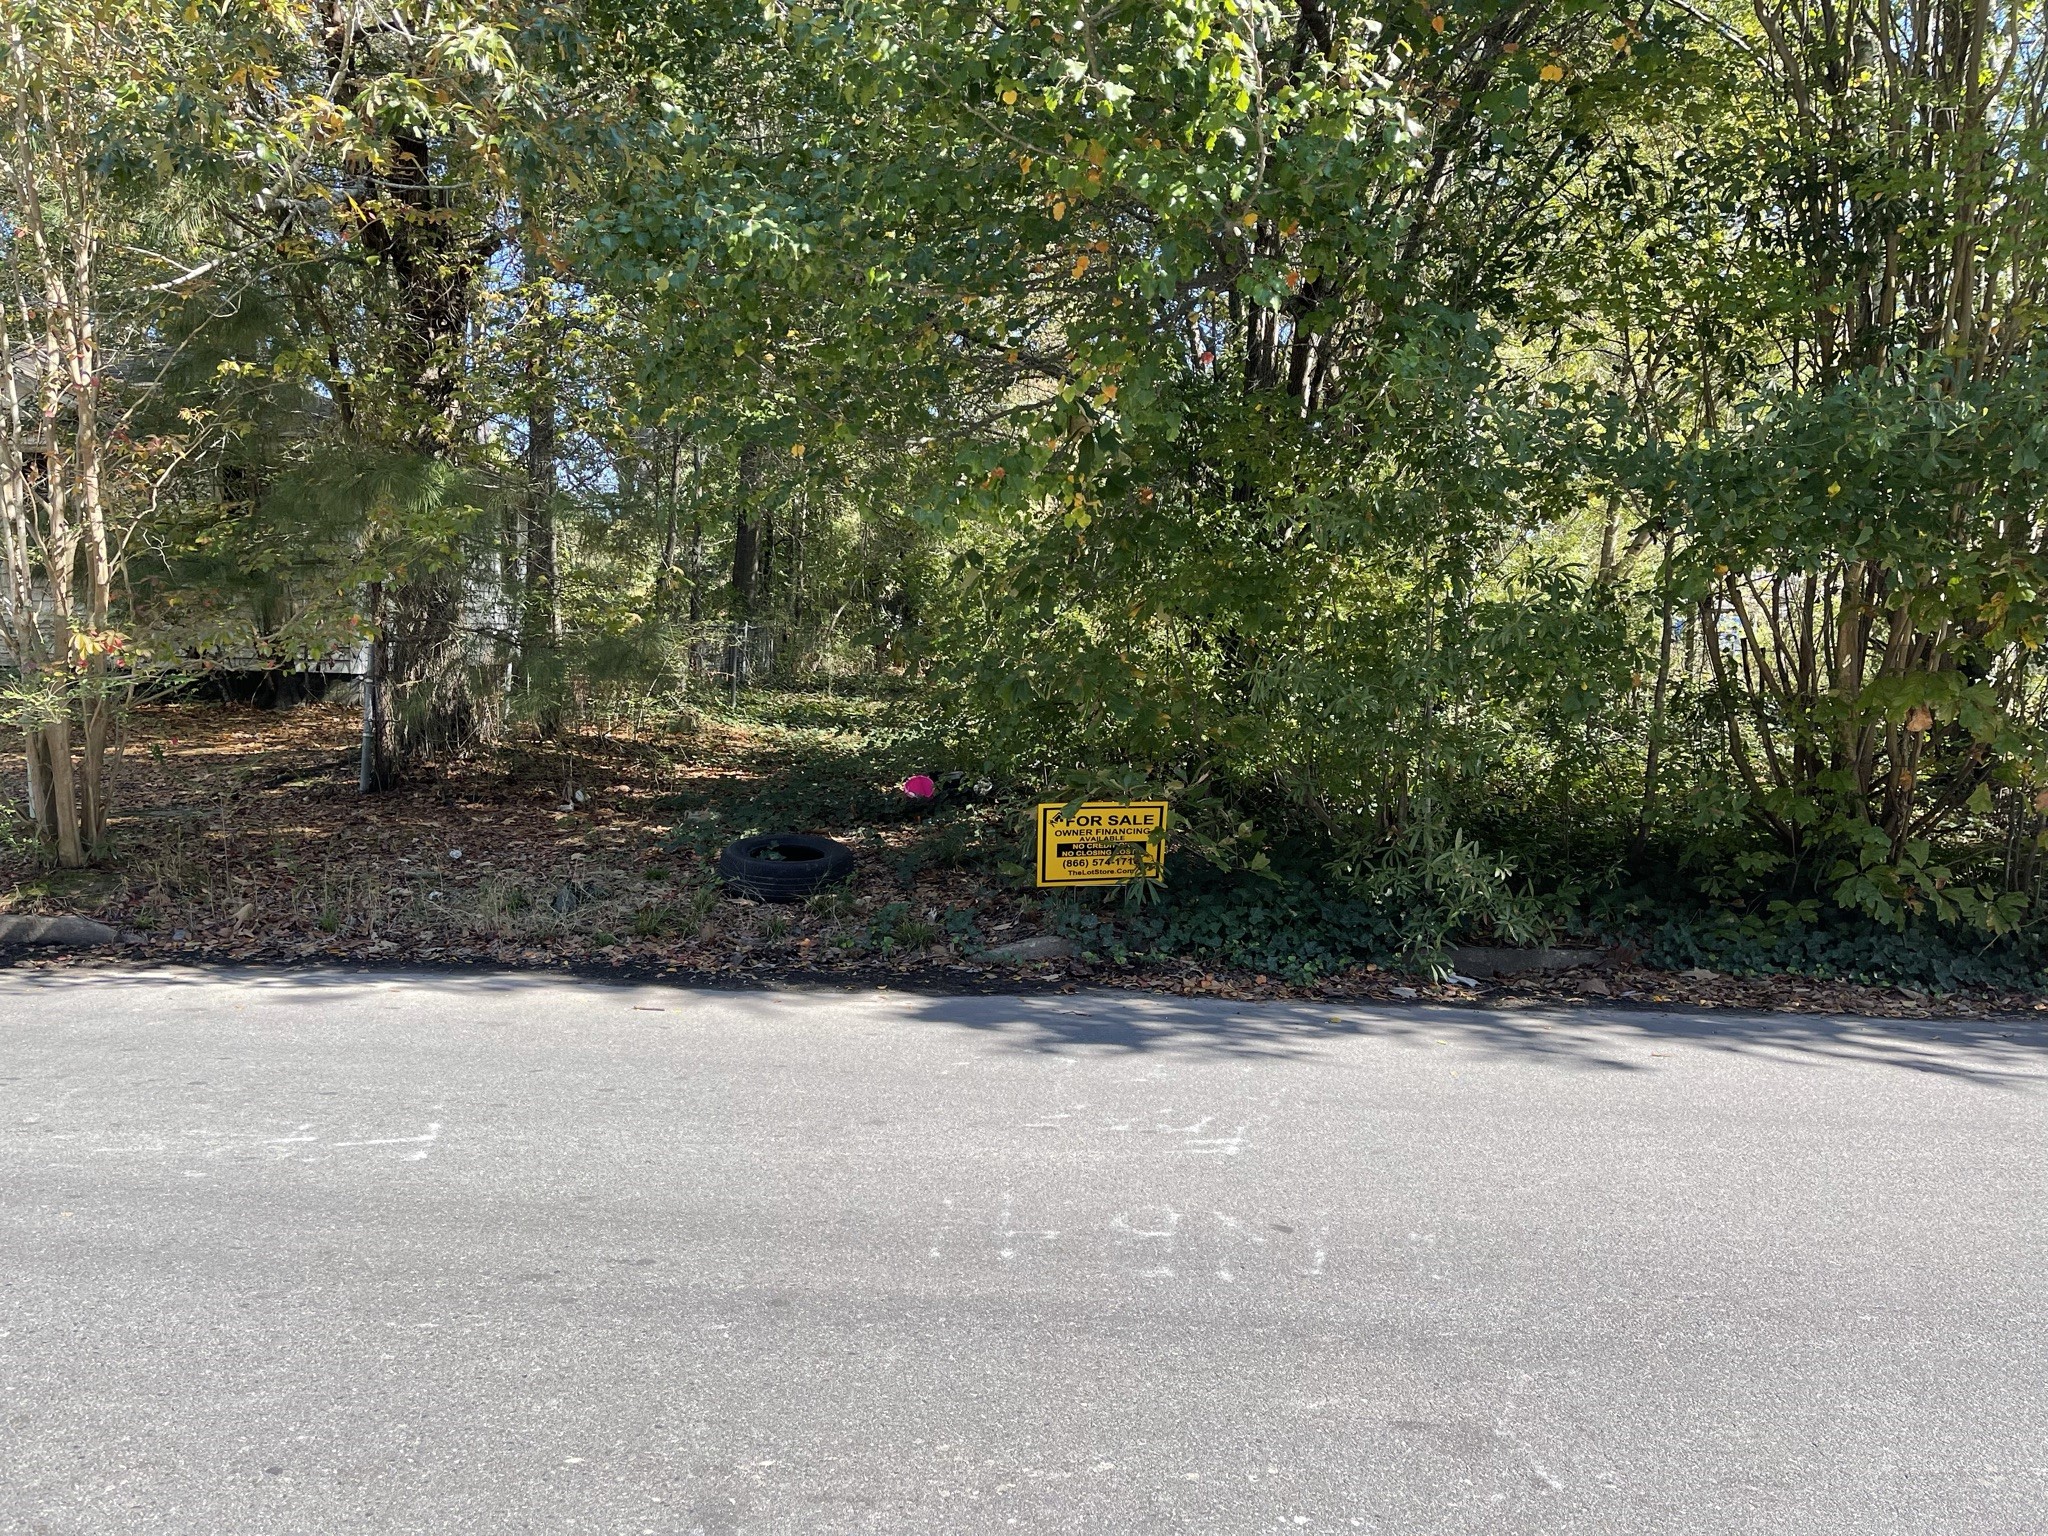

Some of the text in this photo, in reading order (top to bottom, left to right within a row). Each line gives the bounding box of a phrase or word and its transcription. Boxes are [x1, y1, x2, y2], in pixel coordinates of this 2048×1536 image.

[1066, 814, 1154, 827] FOR SALE
[1055, 828, 1151, 837] OWNER FINANCING
[1075, 849, 1112, 857] CLOSING
[1062, 859, 1089, 869] (866)
